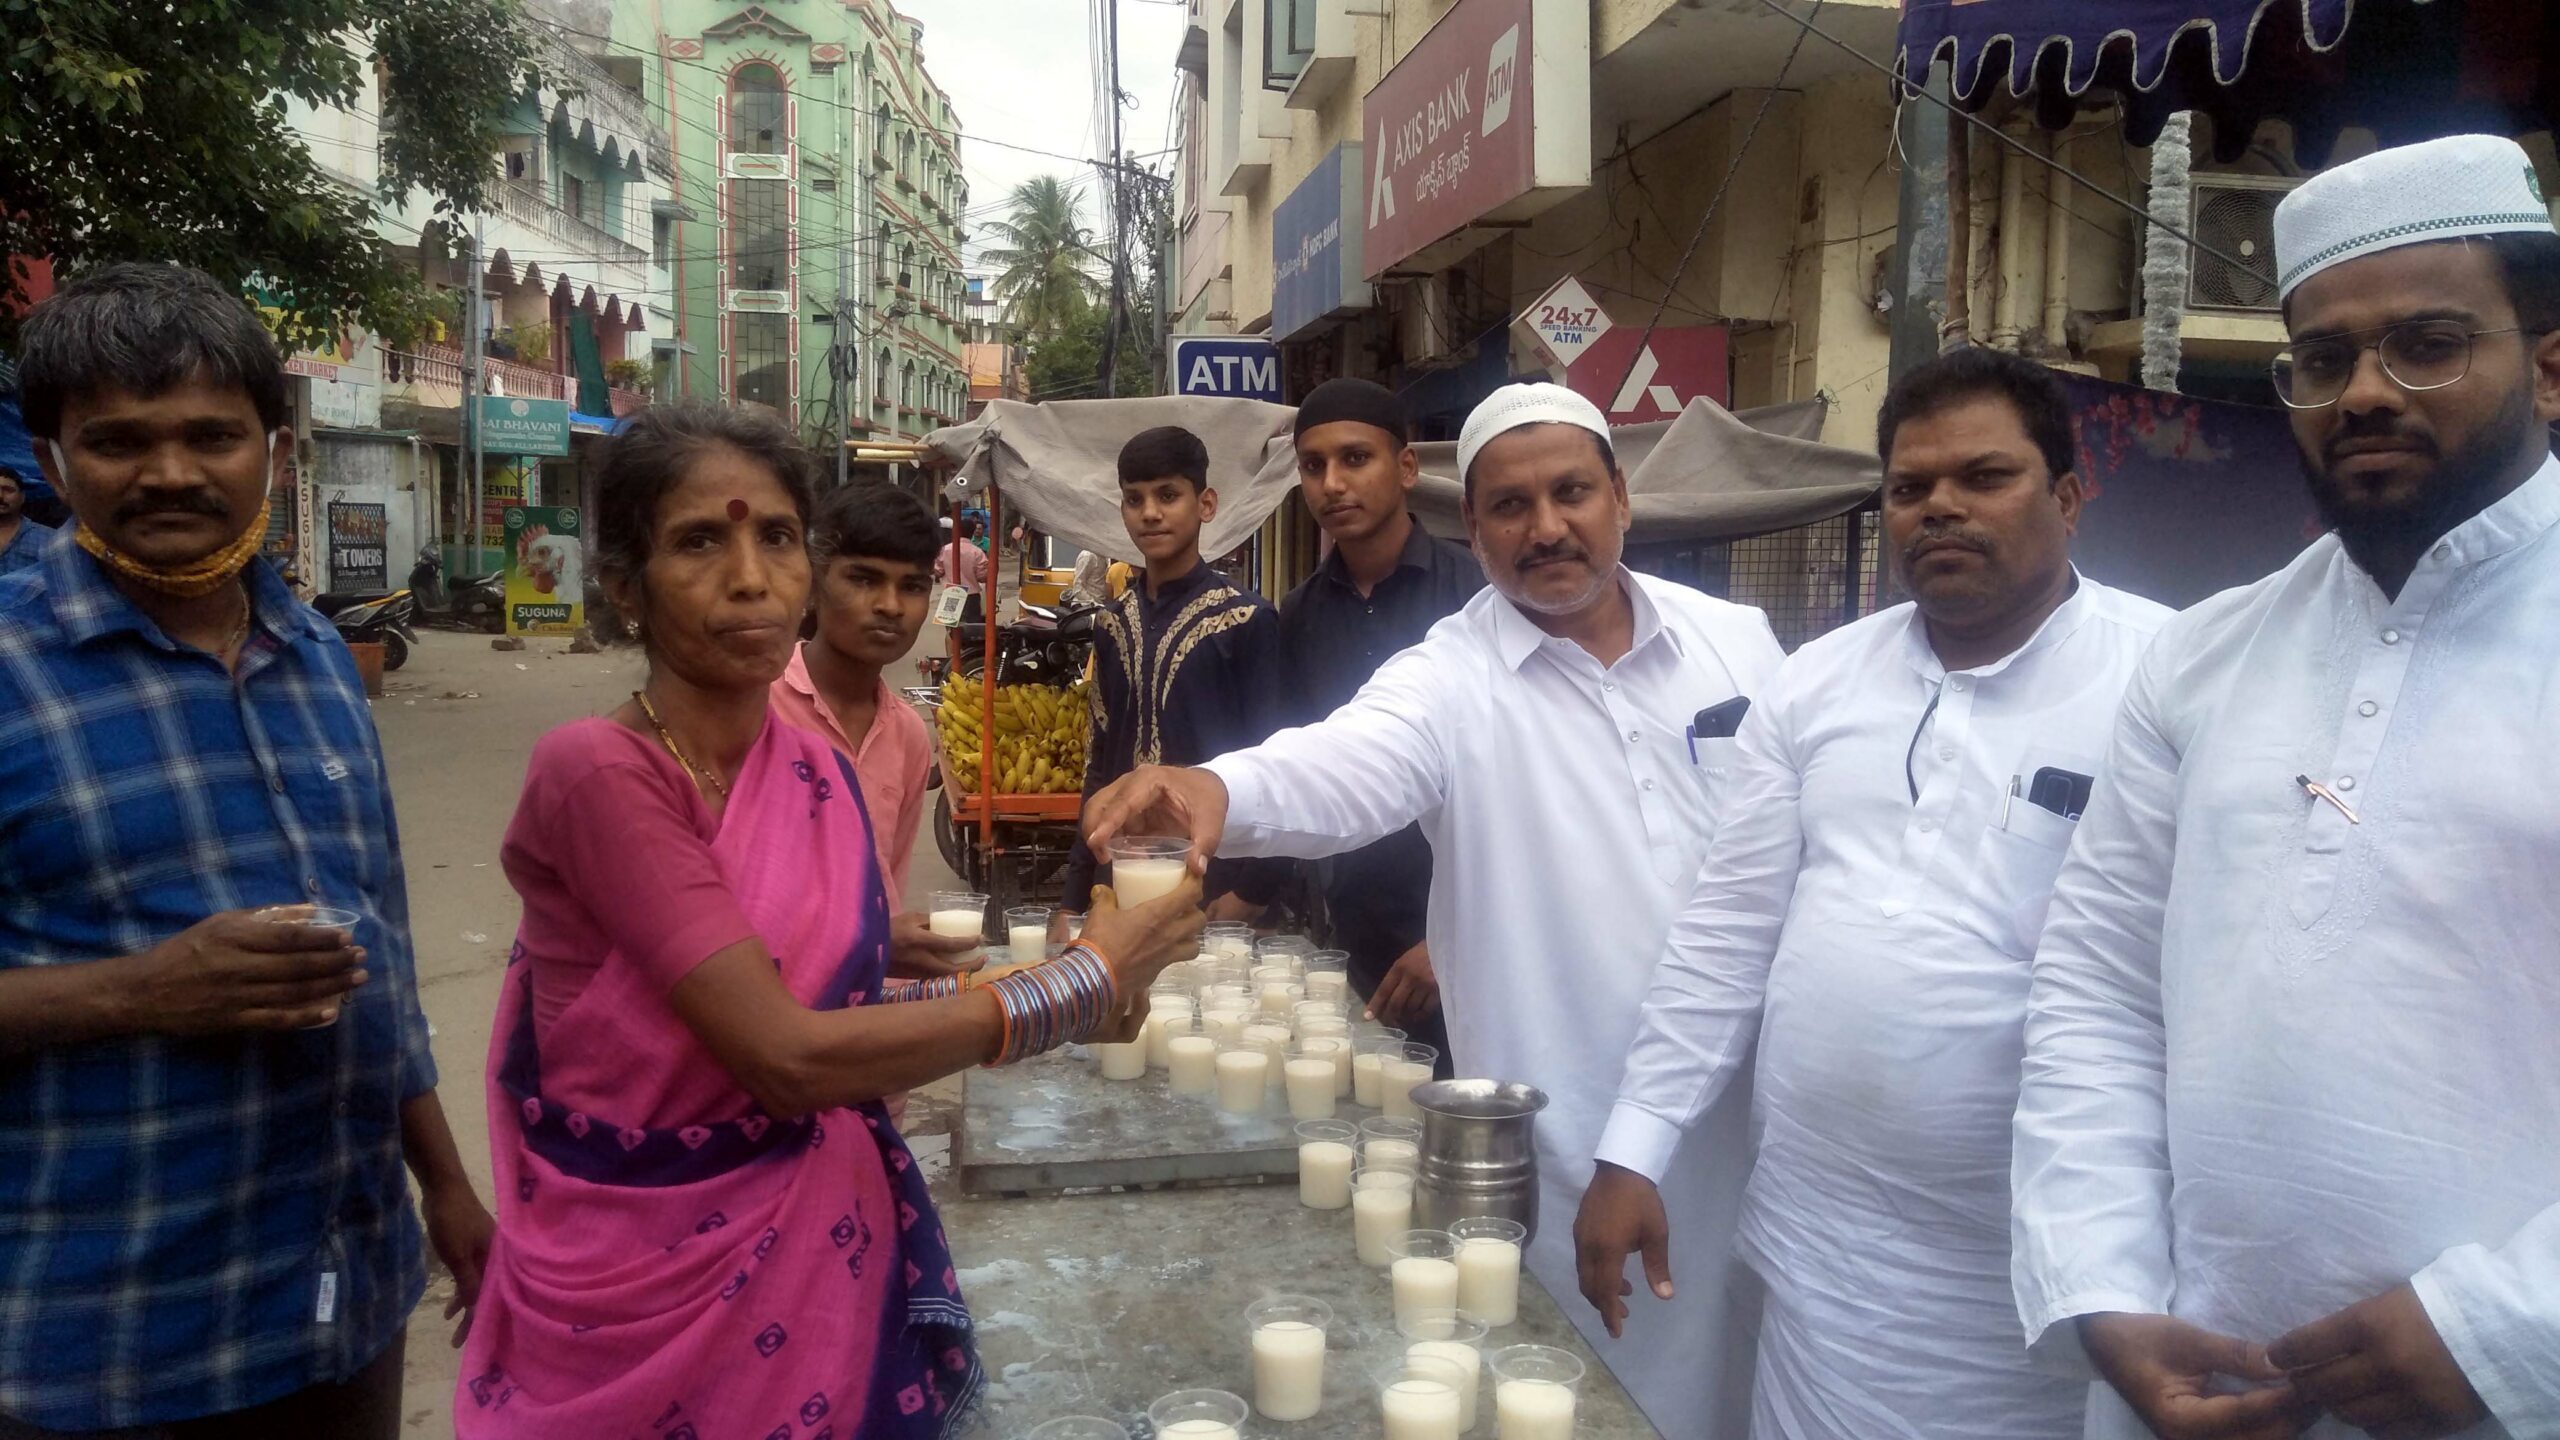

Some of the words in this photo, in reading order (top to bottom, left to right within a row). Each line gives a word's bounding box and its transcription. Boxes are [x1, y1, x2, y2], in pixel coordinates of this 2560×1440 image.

[1486, 56, 1512, 109] ATM
[1393, 111, 1423, 173] AXIS
[1428, 66, 1471, 145] BANK
[1309, 231, 1323, 258] HDFC
[1323, 217, 1338, 248] BANK
[1541, 305, 1598, 326] 24x7
[1553, 332, 1583, 344] ATM
[1563, 325, 1598, 333] BANKING
[306, 361, 339, 379] MARKET
[1186, 355, 1277, 392] ATM
[503, 420, 562, 432] BHAVANI
[301, 488, 311, 582] SUGUNA
[341, 548, 383, 568] TOWERS
[517, 606, 567, 618] SUGUNA
